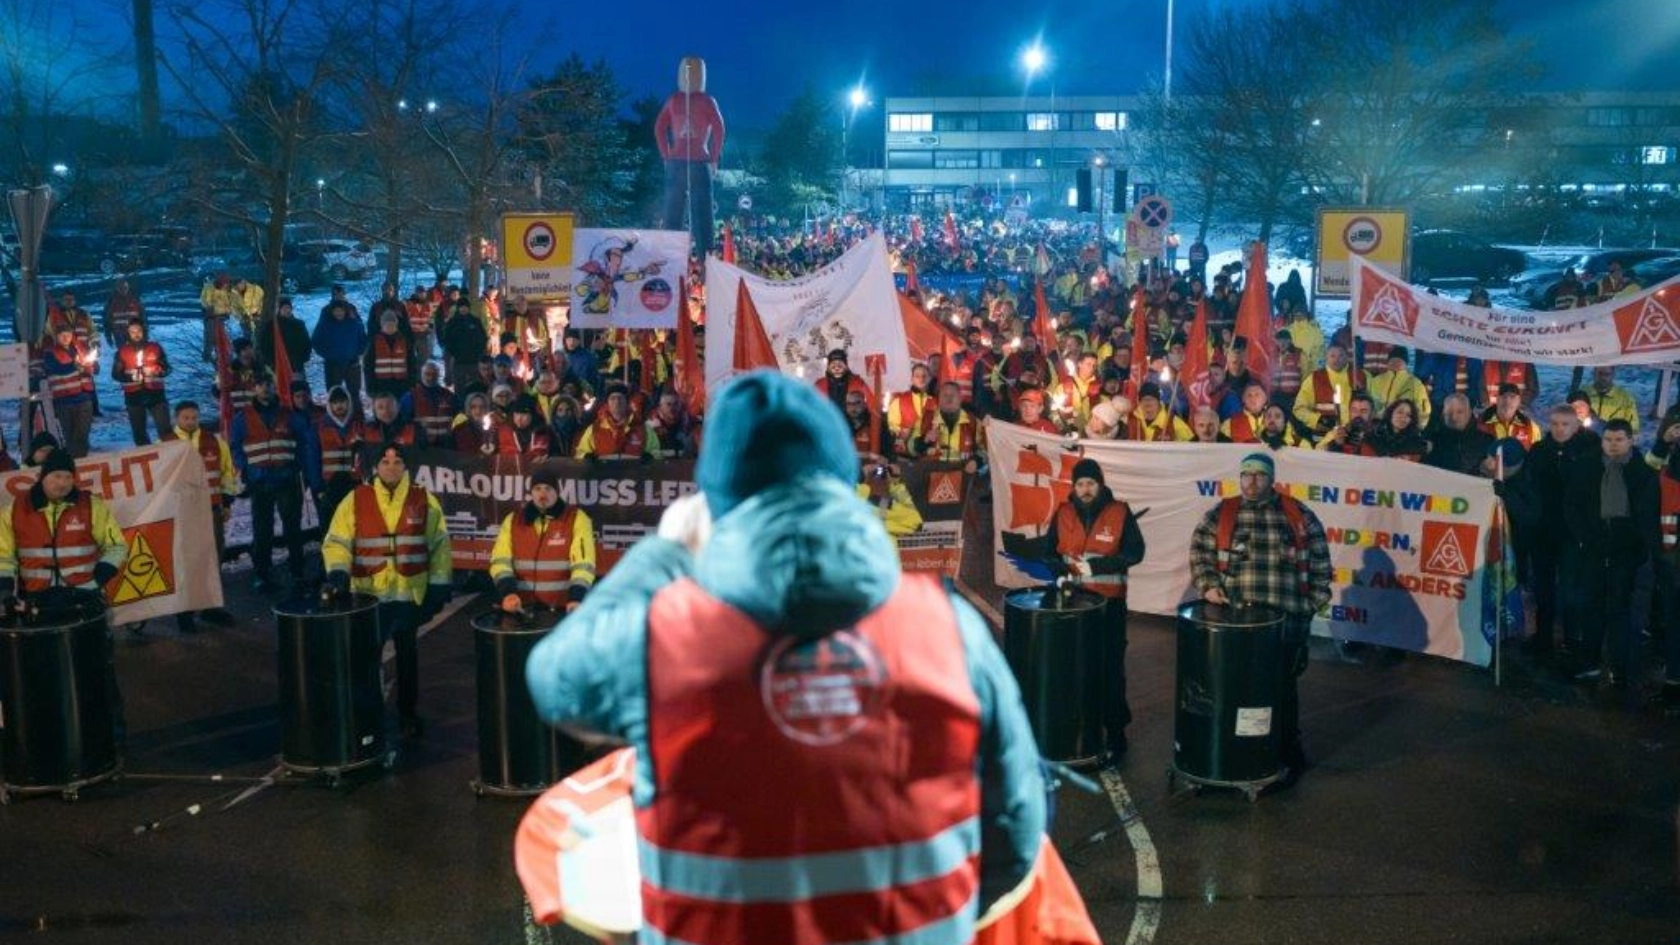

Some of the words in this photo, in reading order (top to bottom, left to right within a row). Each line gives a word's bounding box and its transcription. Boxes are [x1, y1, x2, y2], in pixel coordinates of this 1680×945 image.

[415, 465, 532, 502] ARLOUI
[557, 479, 637, 506] MUSS
[1274, 481, 1339, 504] NNEN
[1345, 488, 1395, 508] DEN
[1400, 491, 1469, 515] WIND
[1326, 527, 1417, 557] NDERN,
[1370, 570, 1467, 600] ANDERS
